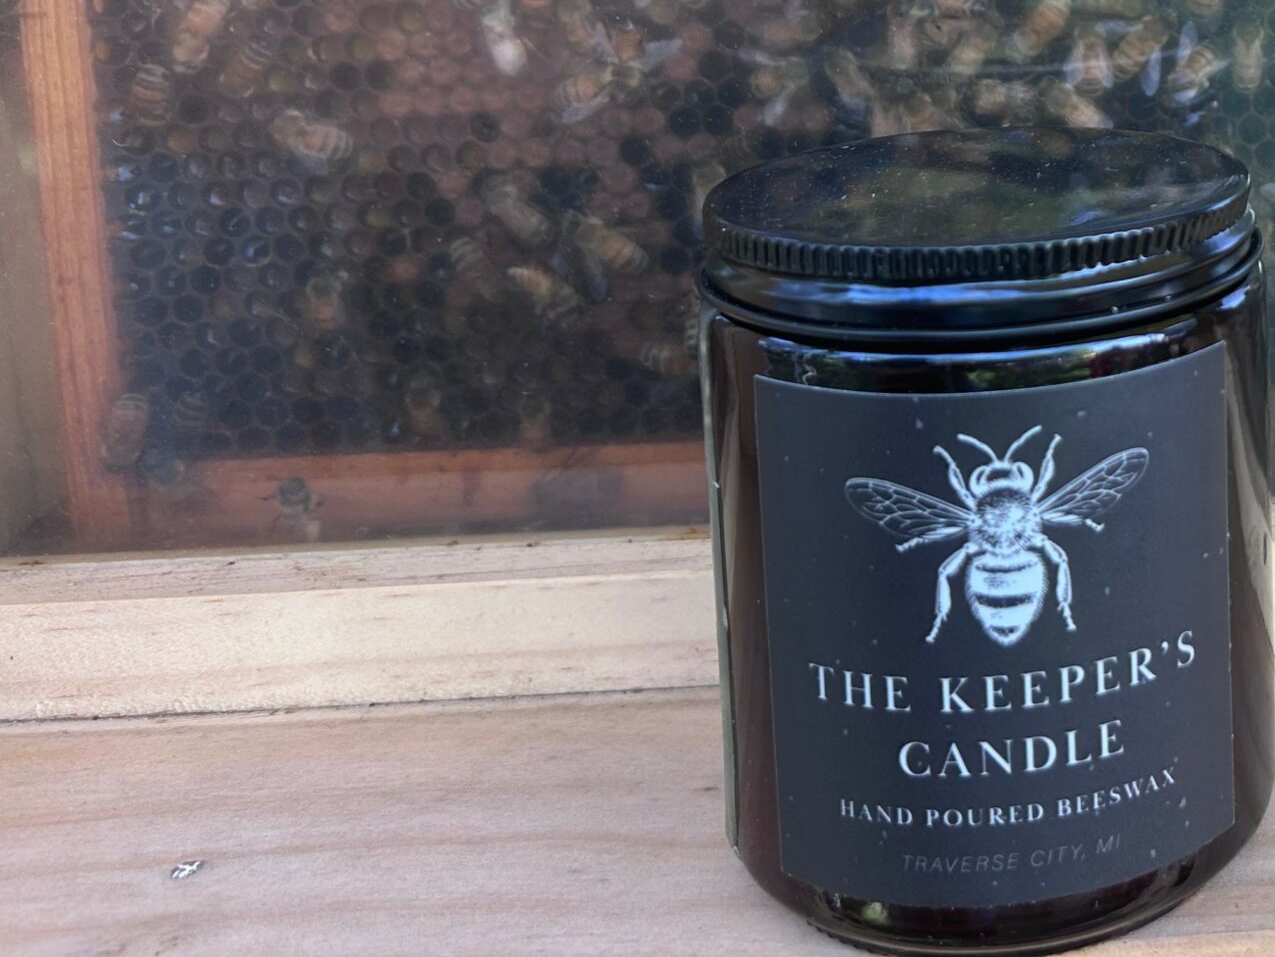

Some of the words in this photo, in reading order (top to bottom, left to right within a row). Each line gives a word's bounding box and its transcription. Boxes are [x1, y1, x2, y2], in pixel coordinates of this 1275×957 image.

[809, 662, 912, 712] THE
[939, 630, 1197, 713] KEEPER'S
[899, 719, 1125, 778] CANDLE
[840, 798, 913, 826] HAND
[926, 802, 1044, 827] POURED
[1057, 766, 1176, 818] BEESWAX
[902, 853, 1019, 874] TRAVERSE
[1030, 843, 1087, 868] CITY,
[1096, 834, 1121, 854] MI
